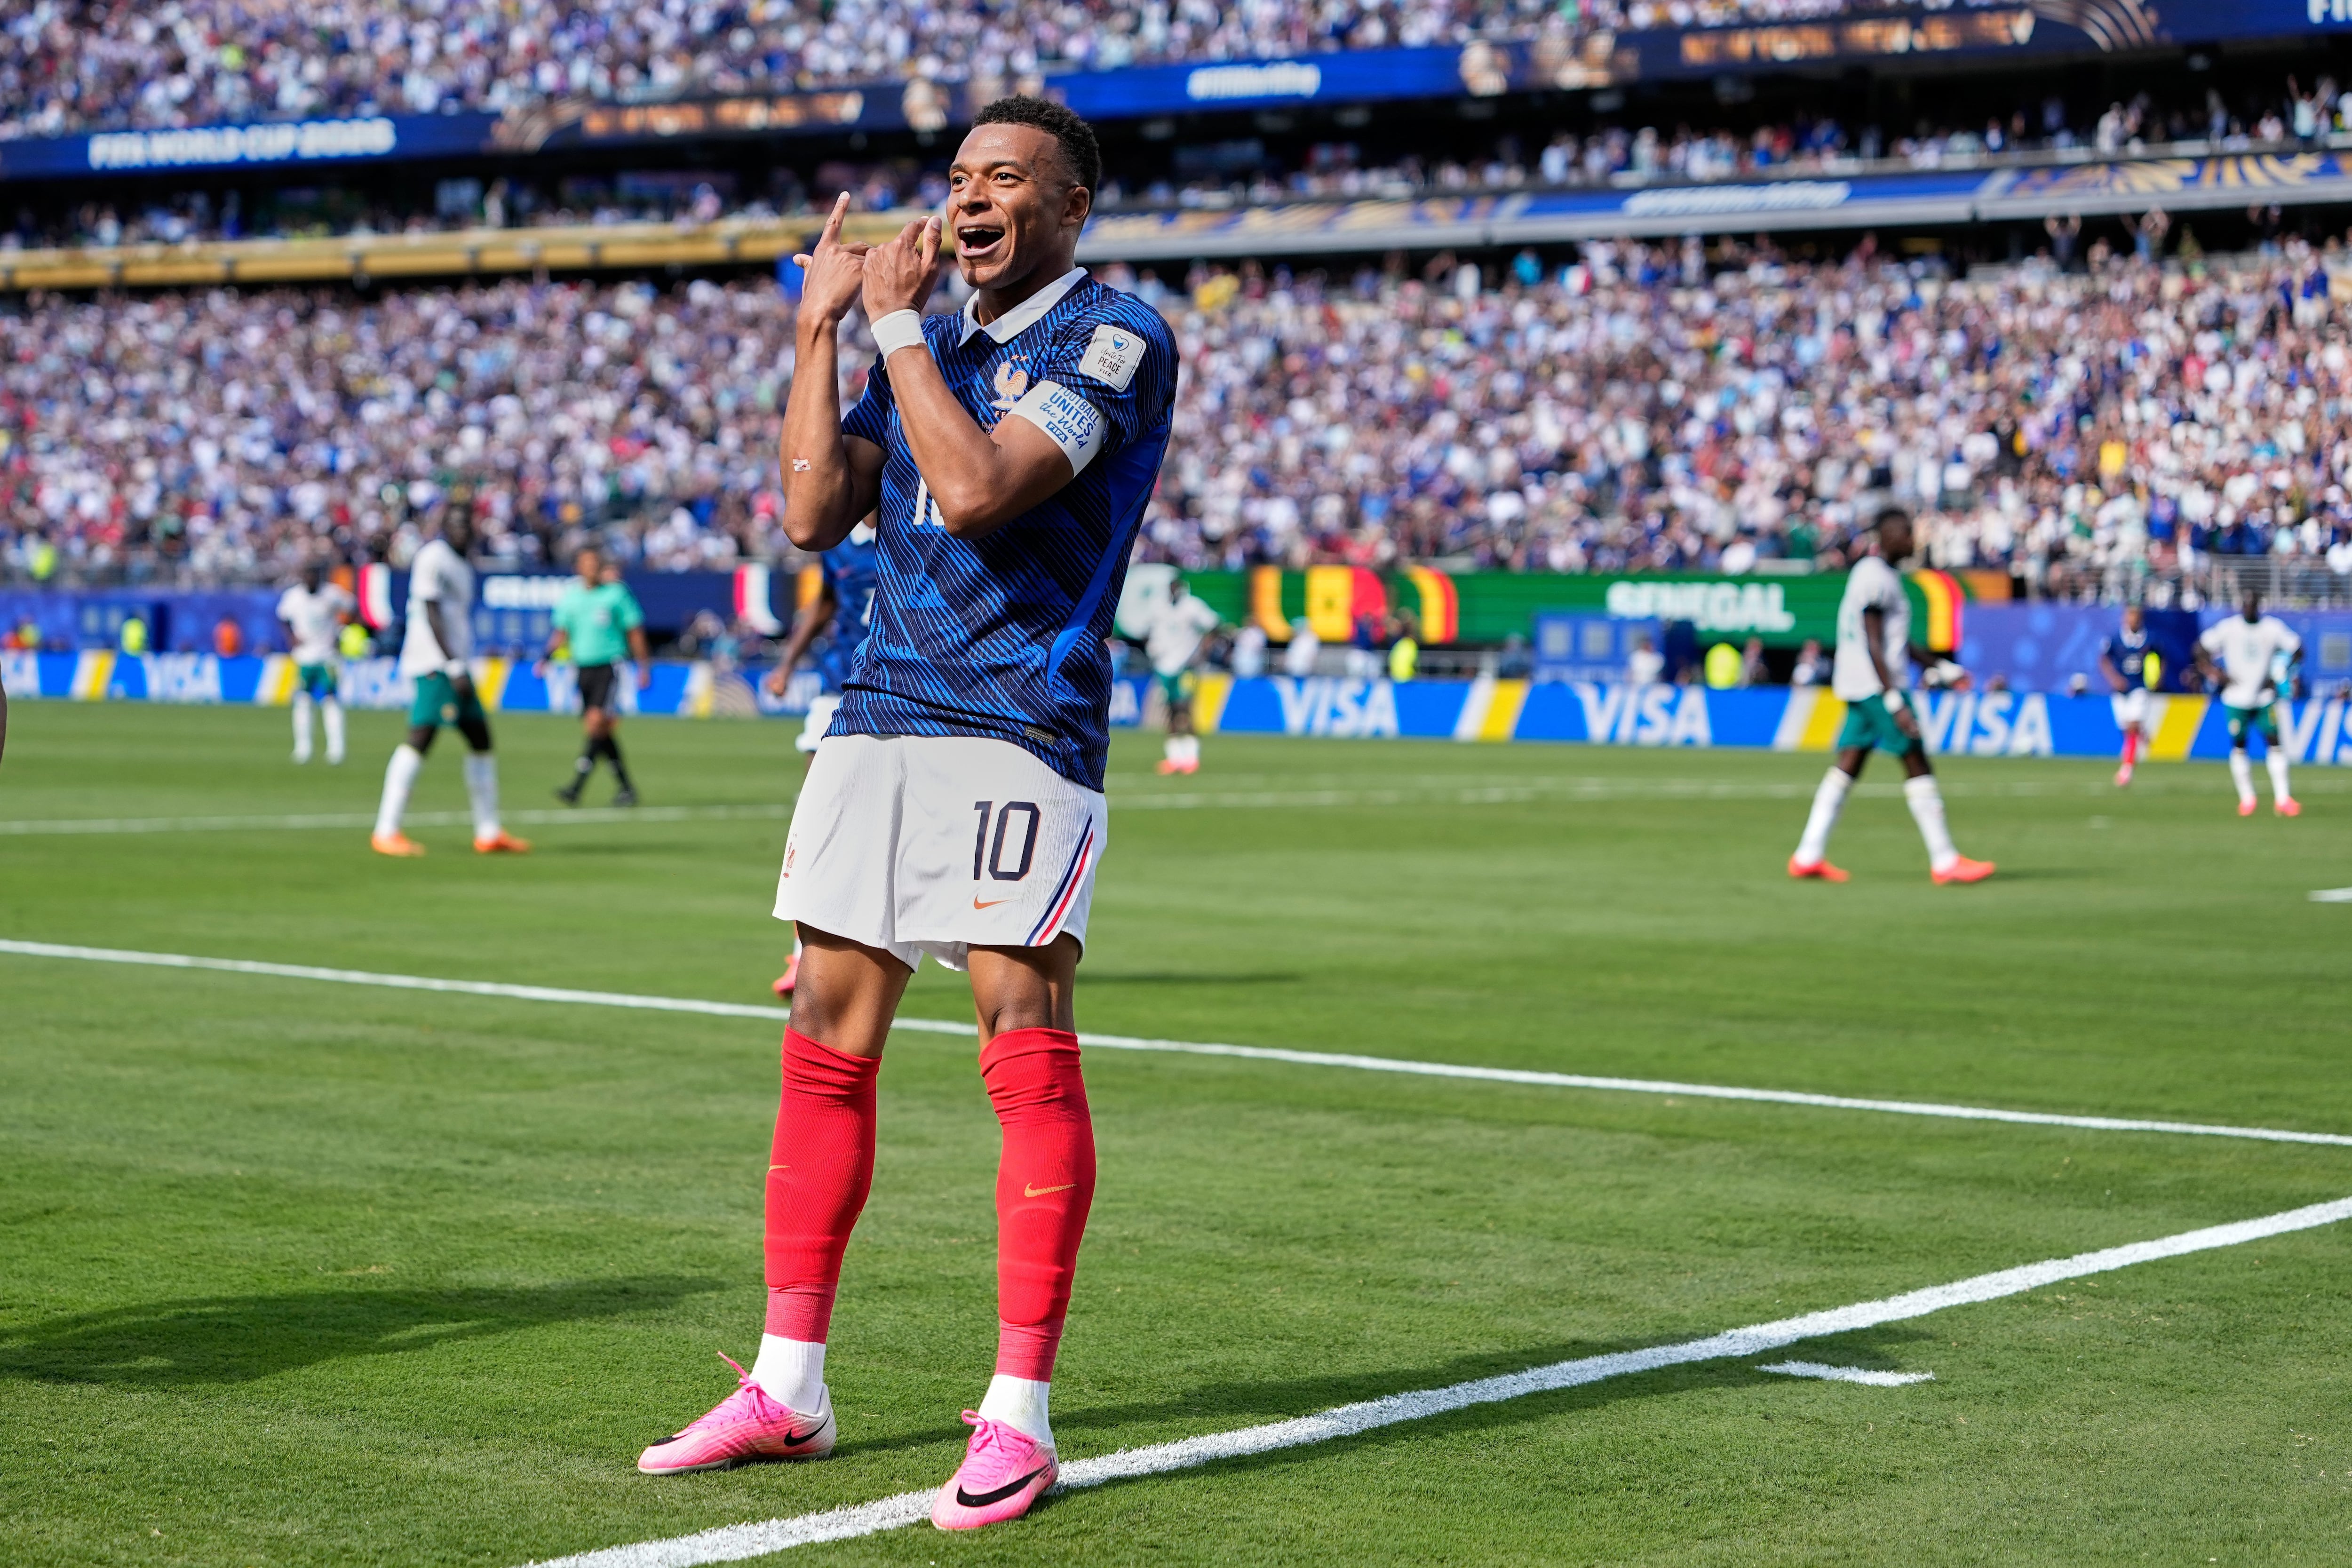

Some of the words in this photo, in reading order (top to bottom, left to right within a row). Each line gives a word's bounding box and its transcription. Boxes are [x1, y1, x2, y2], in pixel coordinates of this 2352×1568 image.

[1097, 357, 1122, 374] PEACE
[1099, 368, 1112, 377] FIFA
[1100, 347, 1117, 359] Unite
[1117, 355, 1127, 365] For
[1040, 402, 1058, 418] the
[1058, 415, 1088, 449] World
[1049, 392, 1094, 437] UNITES
[1058, 386, 1099, 426] FOOTBALL
[1049, 422, 1066, 442] FIFA
[1605, 581, 1796, 633] SENEGAL
[1271, 677, 1399, 738] VISA
[1572, 682, 1713, 746] VISA
[1912, 689, 2053, 756] VISA
[2276, 698, 2352, 766] VI
[973, 801, 1041, 881] 10
